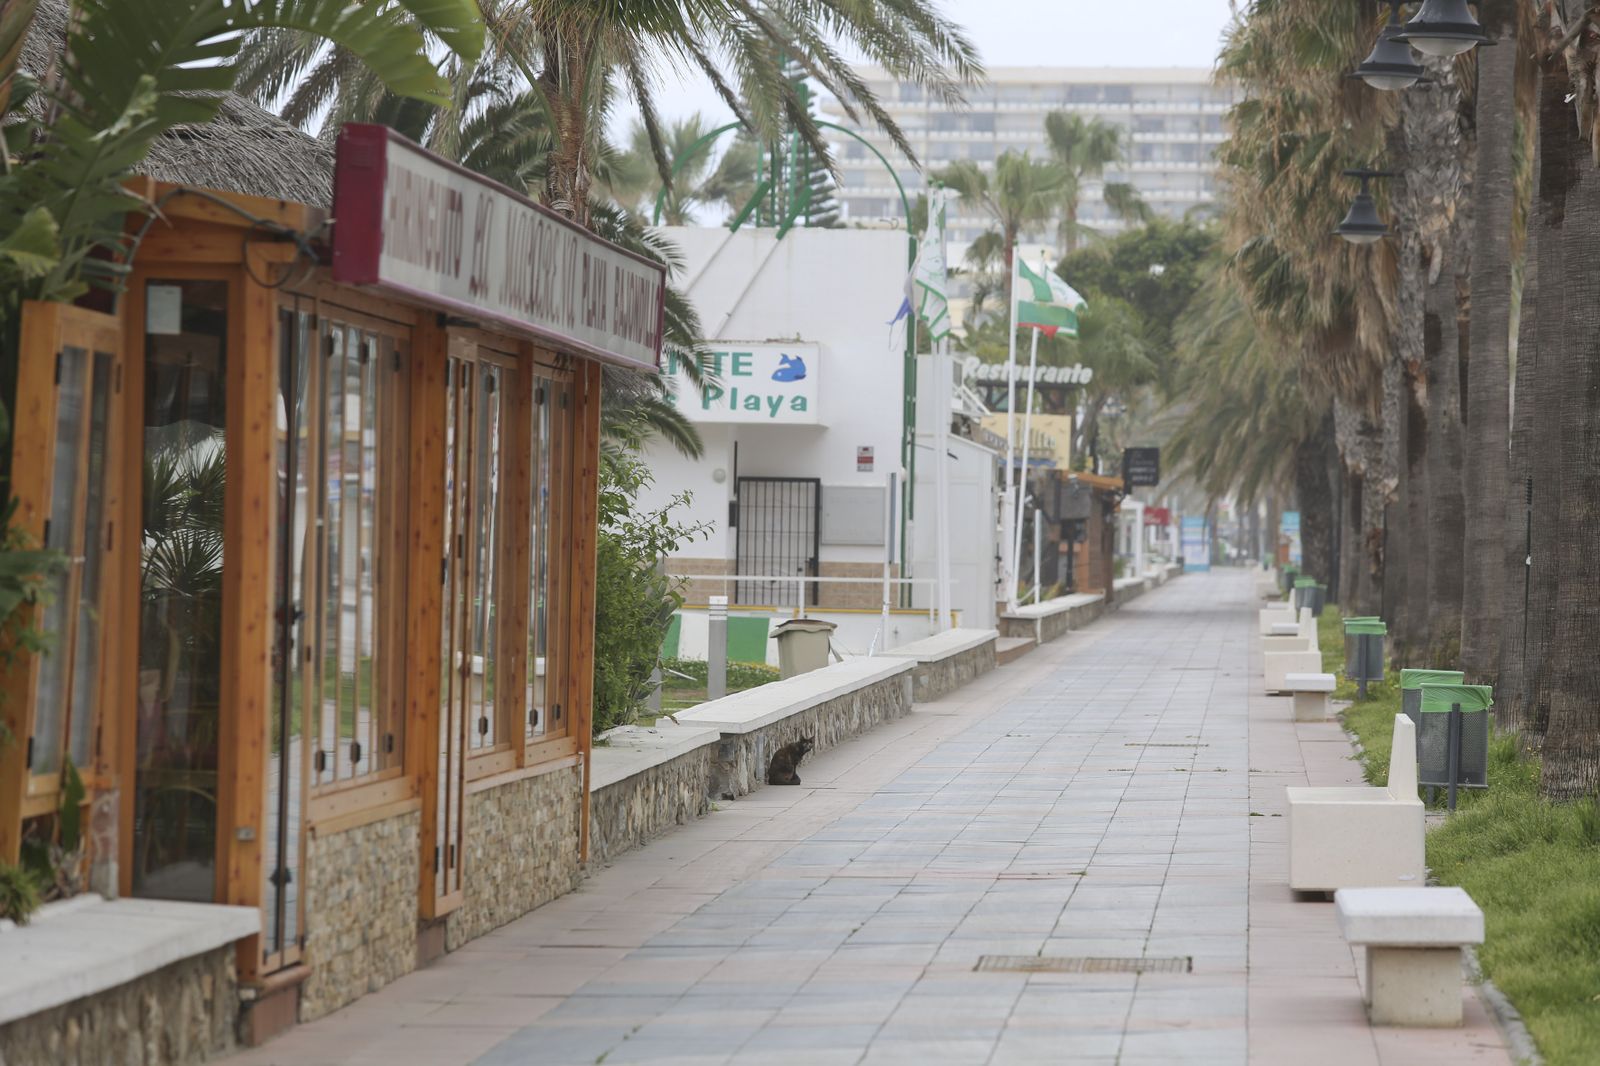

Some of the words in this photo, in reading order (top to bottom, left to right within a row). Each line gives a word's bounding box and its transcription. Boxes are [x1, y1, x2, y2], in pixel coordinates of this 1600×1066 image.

[581, 251, 608, 334] PLAYA
[964, 355, 1093, 385] Restaurante
[701, 385, 808, 418] Playa
